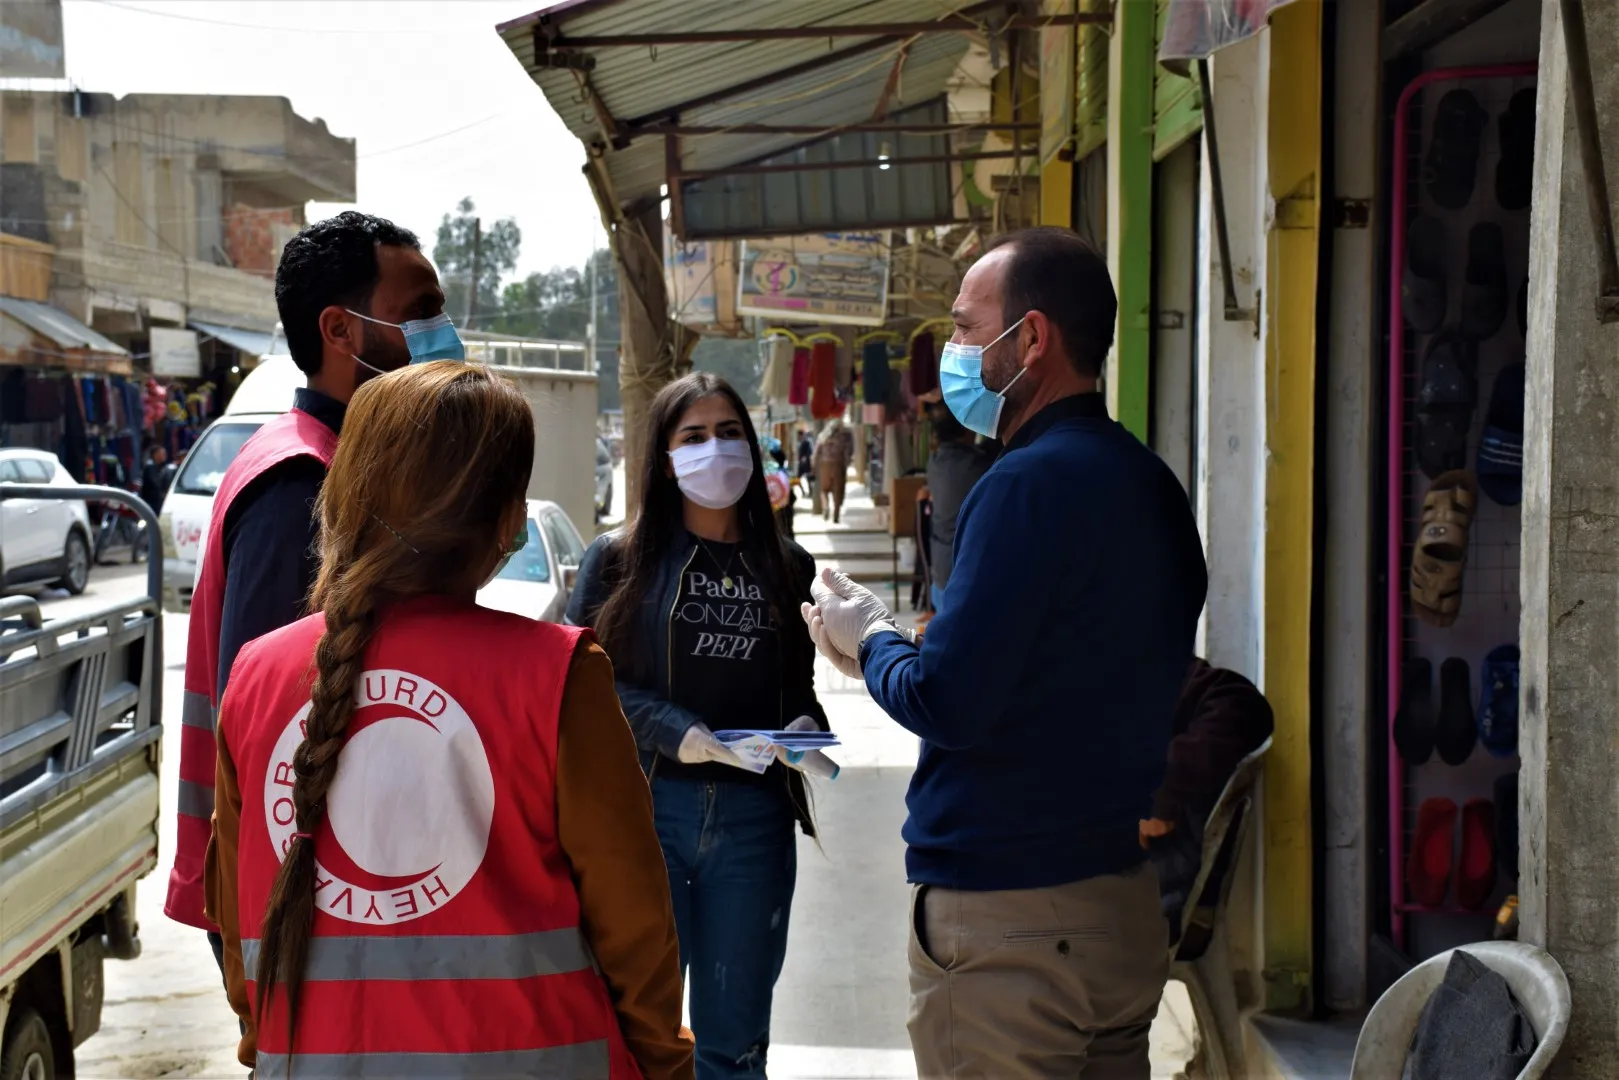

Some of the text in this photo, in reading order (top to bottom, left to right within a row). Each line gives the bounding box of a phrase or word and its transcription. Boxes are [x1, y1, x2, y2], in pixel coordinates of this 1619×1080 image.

[685, 571, 764, 601] Paola
[740, 621, 753, 633] de
[690, 632, 761, 660] PEPI
[366, 675, 448, 718] URD
